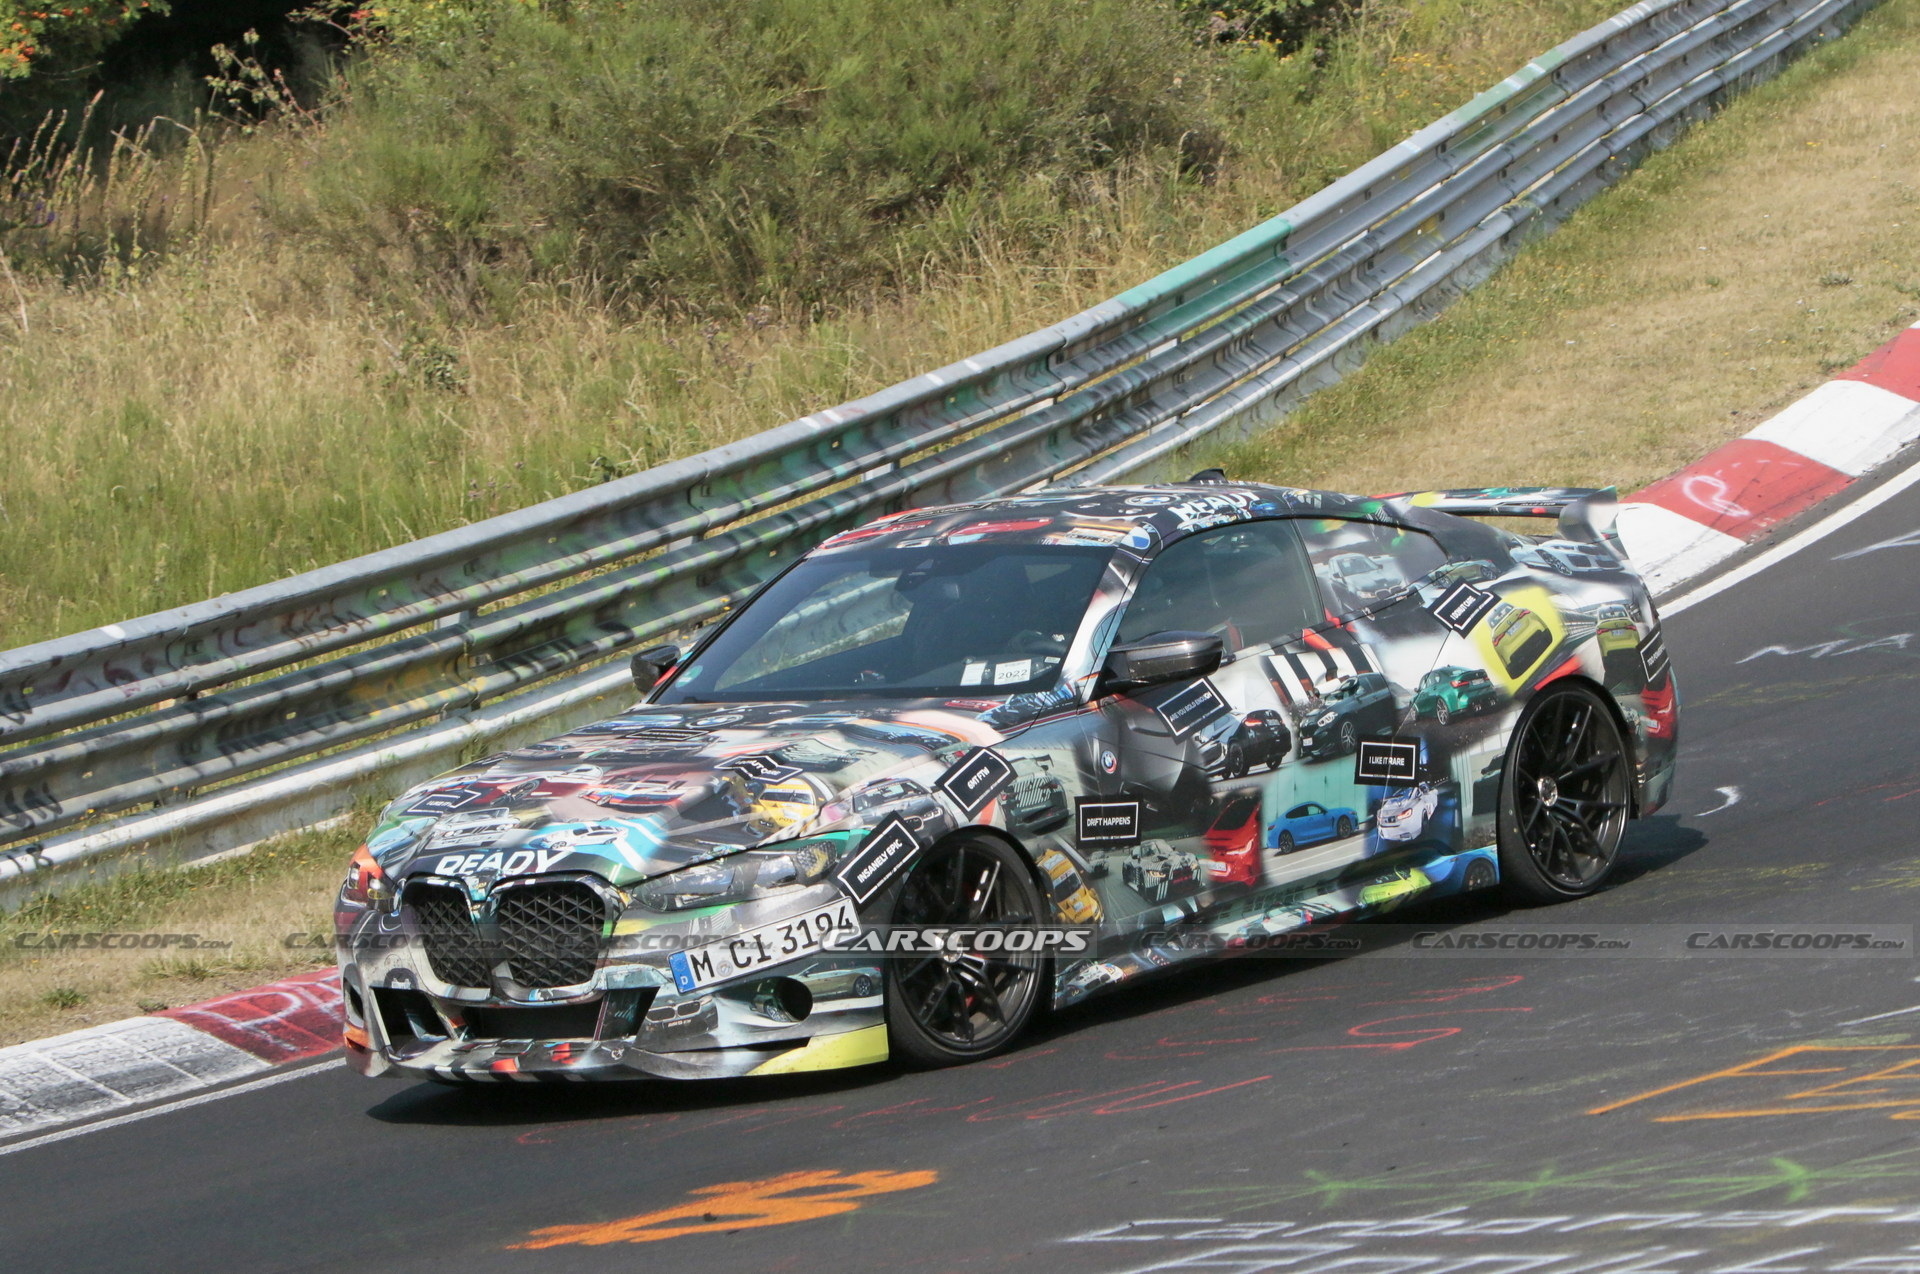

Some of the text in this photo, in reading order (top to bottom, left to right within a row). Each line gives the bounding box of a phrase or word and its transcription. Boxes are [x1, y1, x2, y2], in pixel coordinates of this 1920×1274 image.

[998, 669, 1028, 680] 2022
[1372, 756, 1383, 765] LIKE
[1388, 757, 1405, 766] RARE
[1086, 816, 1131, 826] DRIFT HAPPENS
[434, 850, 570, 876] READY
[856, 850, 889, 883] INSANELY
[885, 838, 903, 857] EPIC
[690, 950, 715, 981] M
[776, 906, 853, 955] 3194
